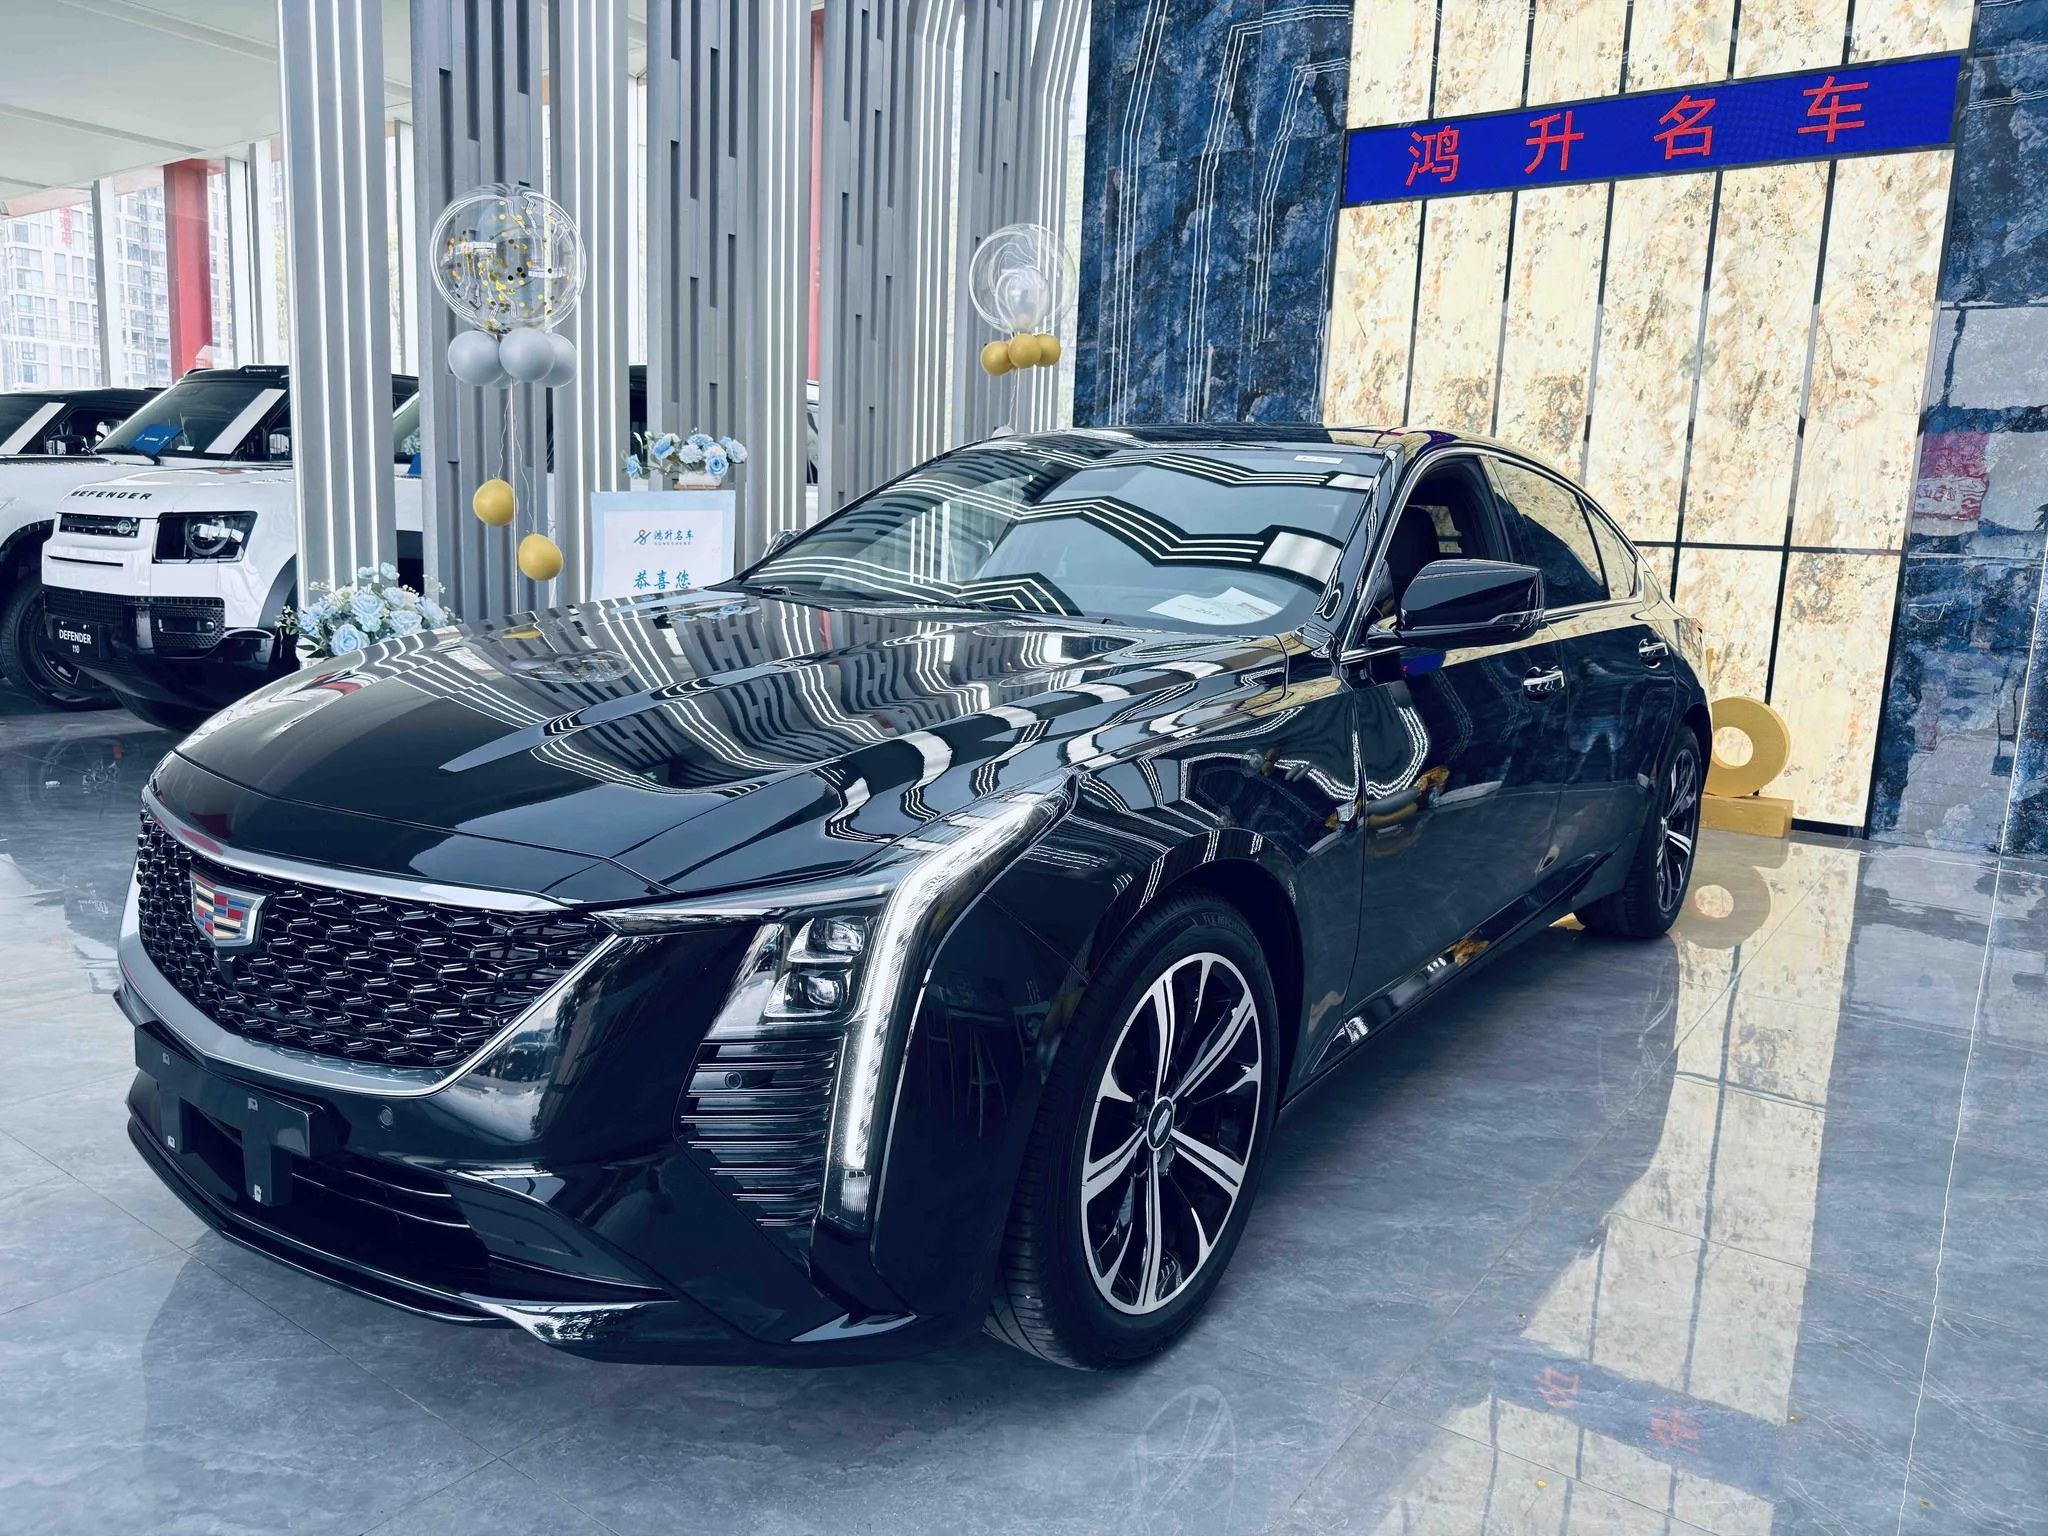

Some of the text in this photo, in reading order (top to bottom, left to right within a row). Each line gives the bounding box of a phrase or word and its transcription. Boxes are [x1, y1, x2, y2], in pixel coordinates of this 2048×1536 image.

[1405, 75, 1869, 186] 鸿升名车
[71, 490, 153, 500] DEFENDER
[633, 569, 691, 590] 恭喜您
[59, 629, 92, 645] DEFENDER
[72, 644, 80, 654] 110
